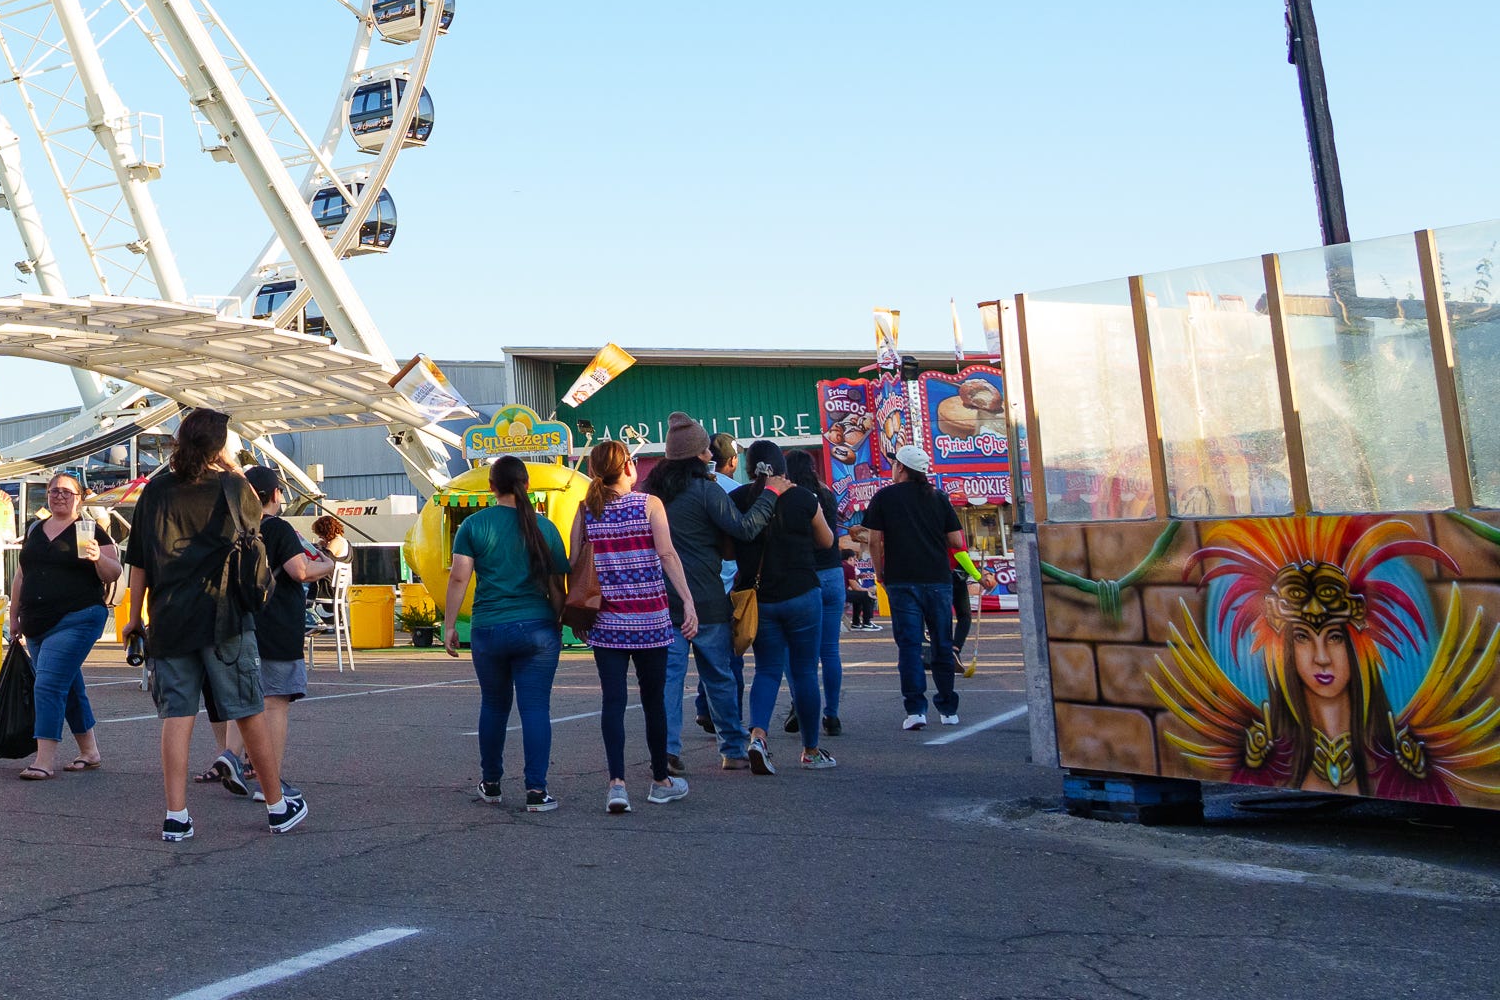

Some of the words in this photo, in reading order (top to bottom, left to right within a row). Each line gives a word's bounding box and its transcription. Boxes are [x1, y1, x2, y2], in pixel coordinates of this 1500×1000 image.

[827, 388, 848, 397] Fried
[824, 400, 867, 416] OREOS
[597, 413, 812, 444] AGRILTURE
[471, 431, 561, 452] Squeezers
[936, 435, 974, 458] Fried
[963, 479, 1007, 495] COOKIE
